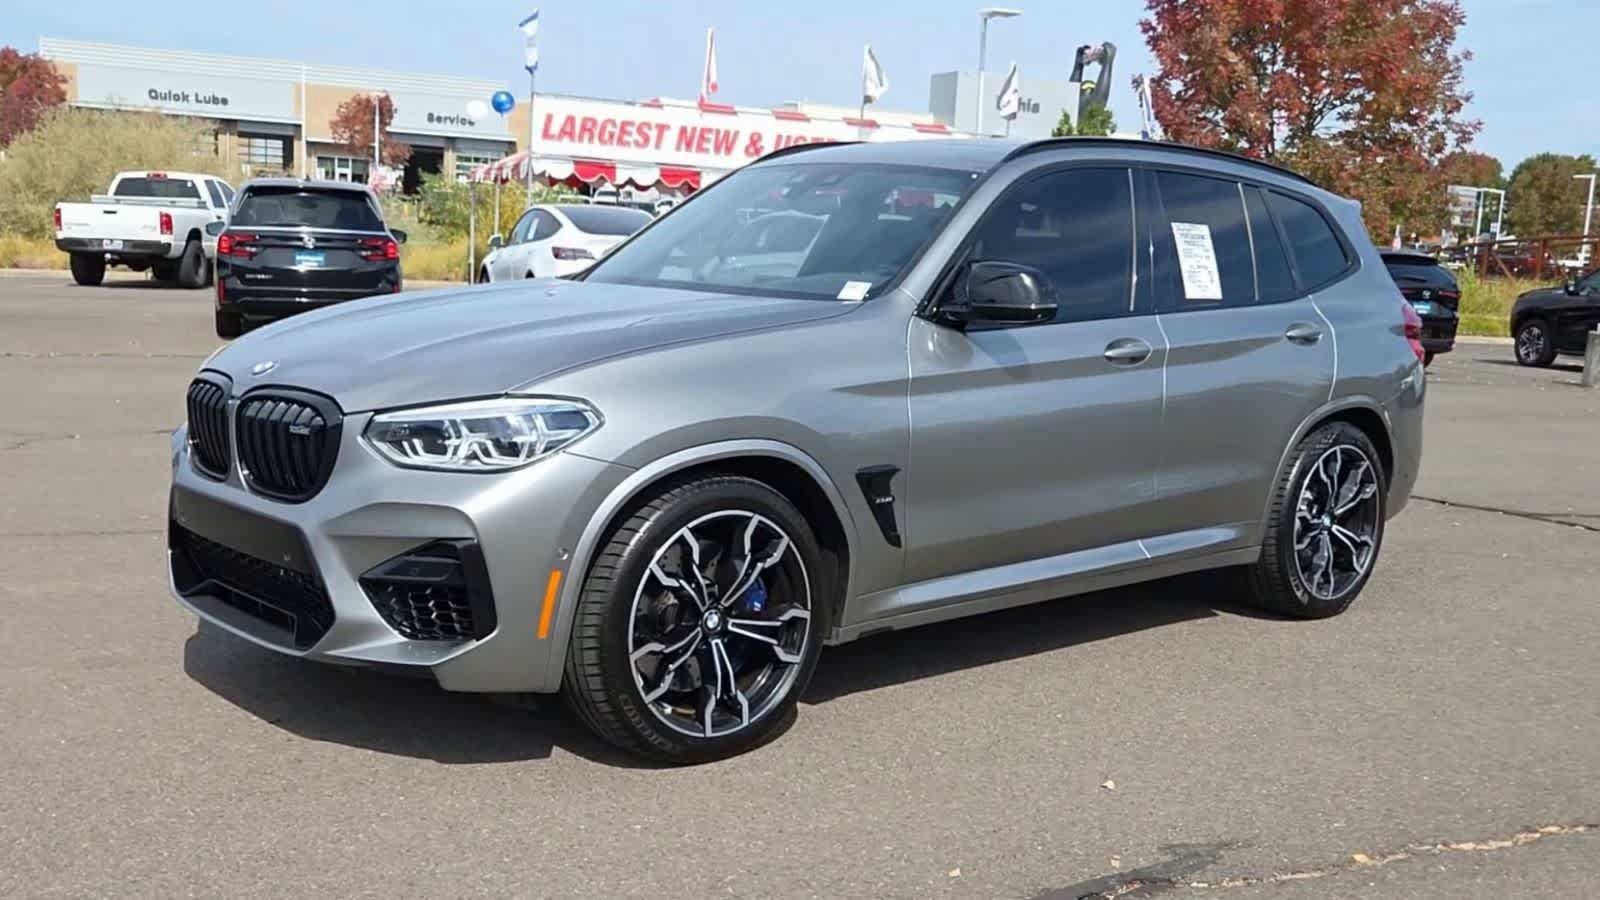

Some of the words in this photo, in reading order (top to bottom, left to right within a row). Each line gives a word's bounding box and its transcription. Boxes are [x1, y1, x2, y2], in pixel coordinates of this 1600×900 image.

[148, 88, 190, 103] Quick
[194, 92, 229, 106] Lube
[542, 112, 671, 150] LARGEST
[675, 125, 740, 157] NEW
[744, 132, 764, 158] &
